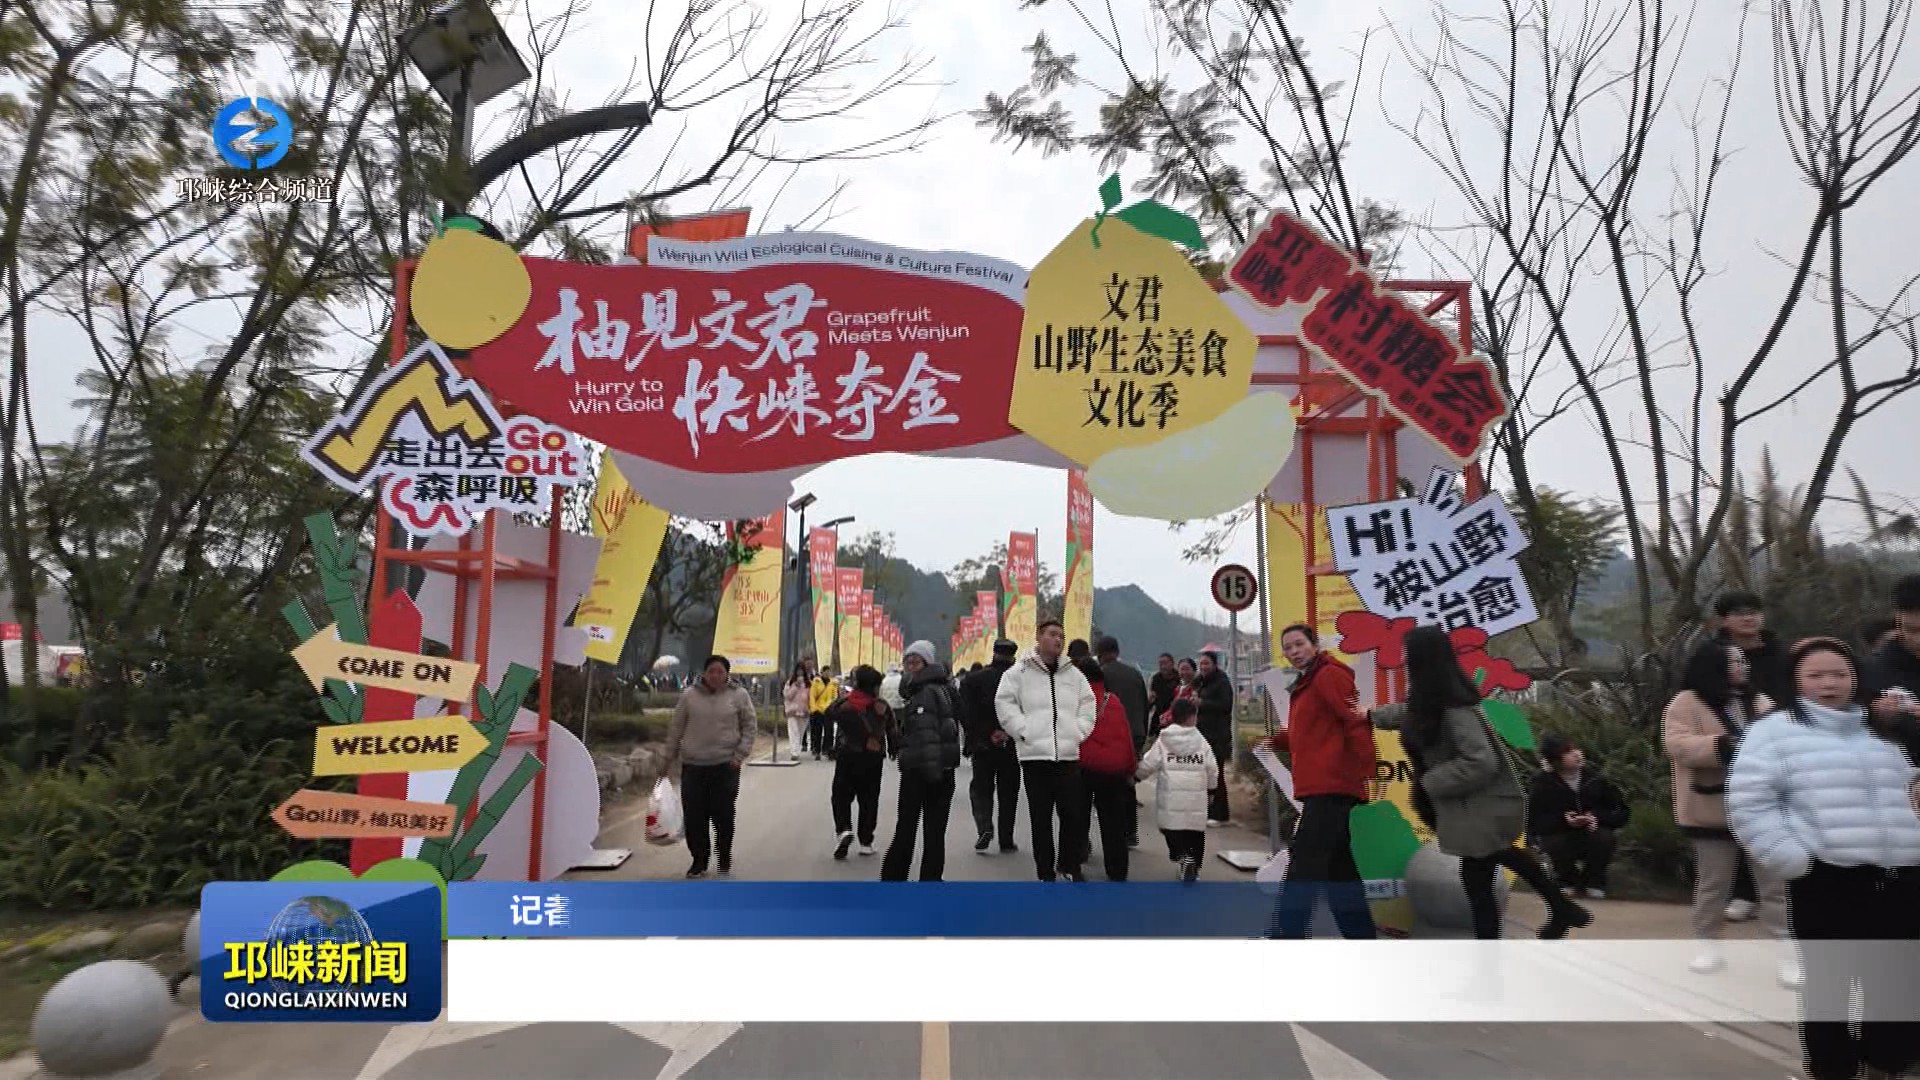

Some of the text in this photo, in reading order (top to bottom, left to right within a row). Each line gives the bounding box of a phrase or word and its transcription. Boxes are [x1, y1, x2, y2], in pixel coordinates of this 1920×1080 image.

[657, 240, 1014, 284] Wenjun Wild Ecological Cuisine & Culture Festival
[1100, 272, 1164, 323] 文君
[826, 306, 932, 328] Grapefruit
[828, 323, 970, 346] Meets Wenjun
[1034, 323, 1229, 378] 山野生态美食
[1325, 278, 1497, 428] 村糖会
[568, 395, 665, 414] Win Gold
[574, 378, 664, 399] Hurry to
[1081, 378, 1180, 430] 文化季
[672, 350, 962, 461] 快崃夺金
[507, 422, 567, 451] Go
[381, 437, 505, 470] 走出去
[504, 451, 578, 477] out
[413, 472, 538, 505] 森呼吸
[1345, 508, 1418, 557] Hi!
[1373, 509, 1509, 612] 被山野
[1222, 576, 1246, 599] 15
[1421, 575, 1521, 630] 治愈
[337, 656, 452, 683] COME ON
[331, 734, 459, 755] WELCOME
